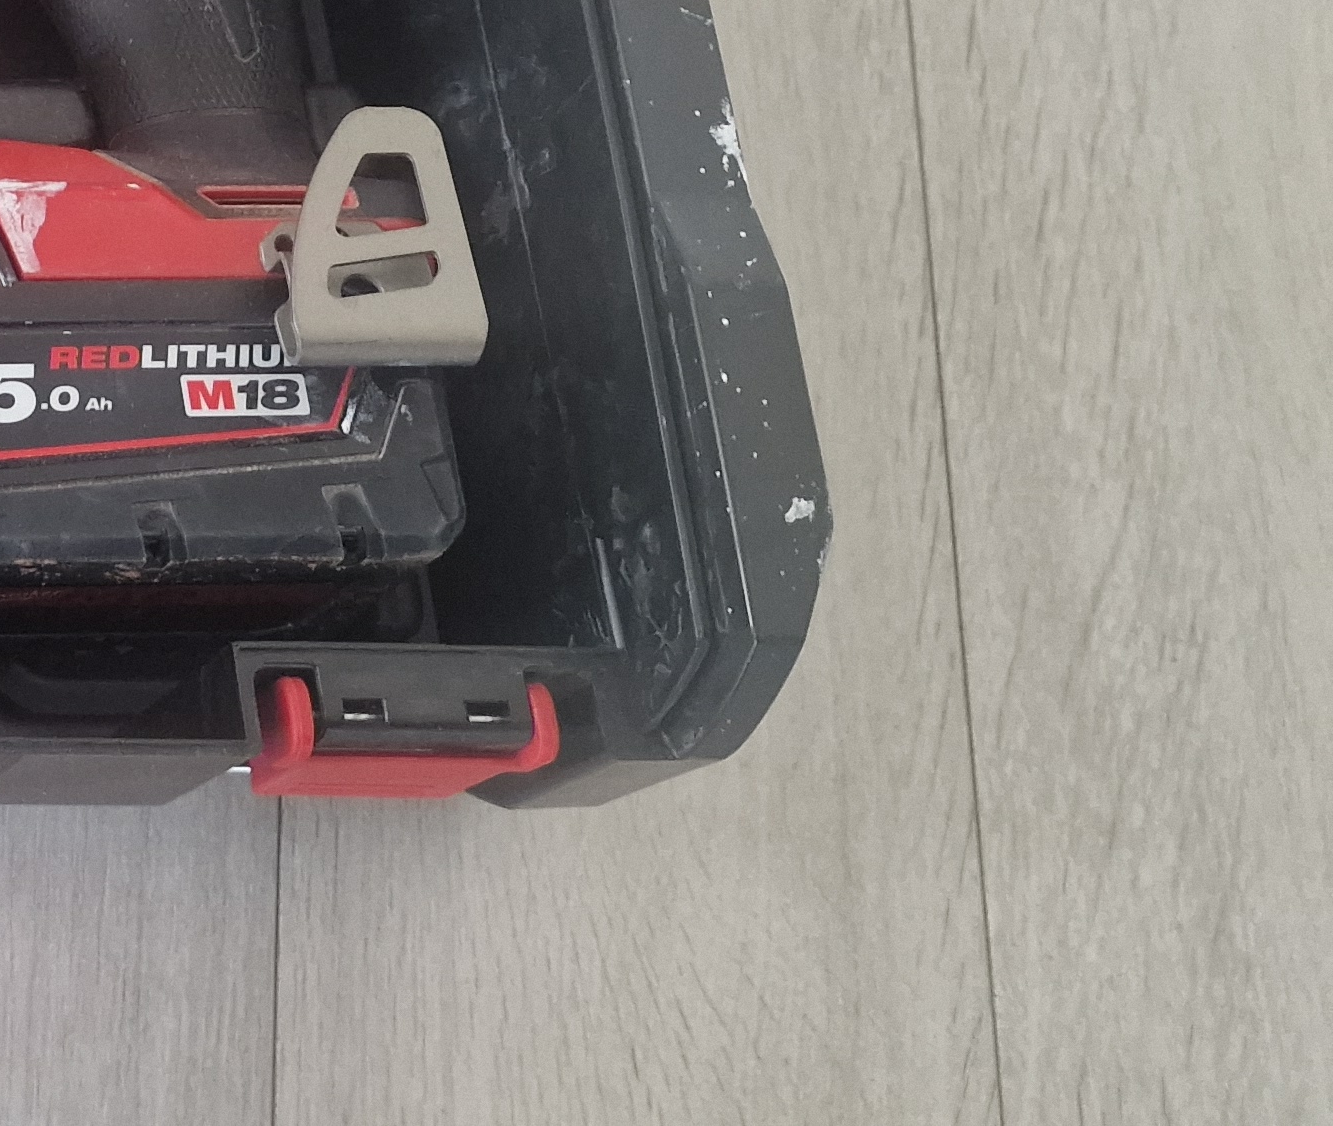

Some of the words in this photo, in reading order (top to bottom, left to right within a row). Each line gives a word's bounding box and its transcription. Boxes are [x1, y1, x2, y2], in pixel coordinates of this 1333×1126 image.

[49, 344, 293, 369] REDLITHIU
[85, 398, 113, 411] Ah
[186, 379, 301, 411] M18
